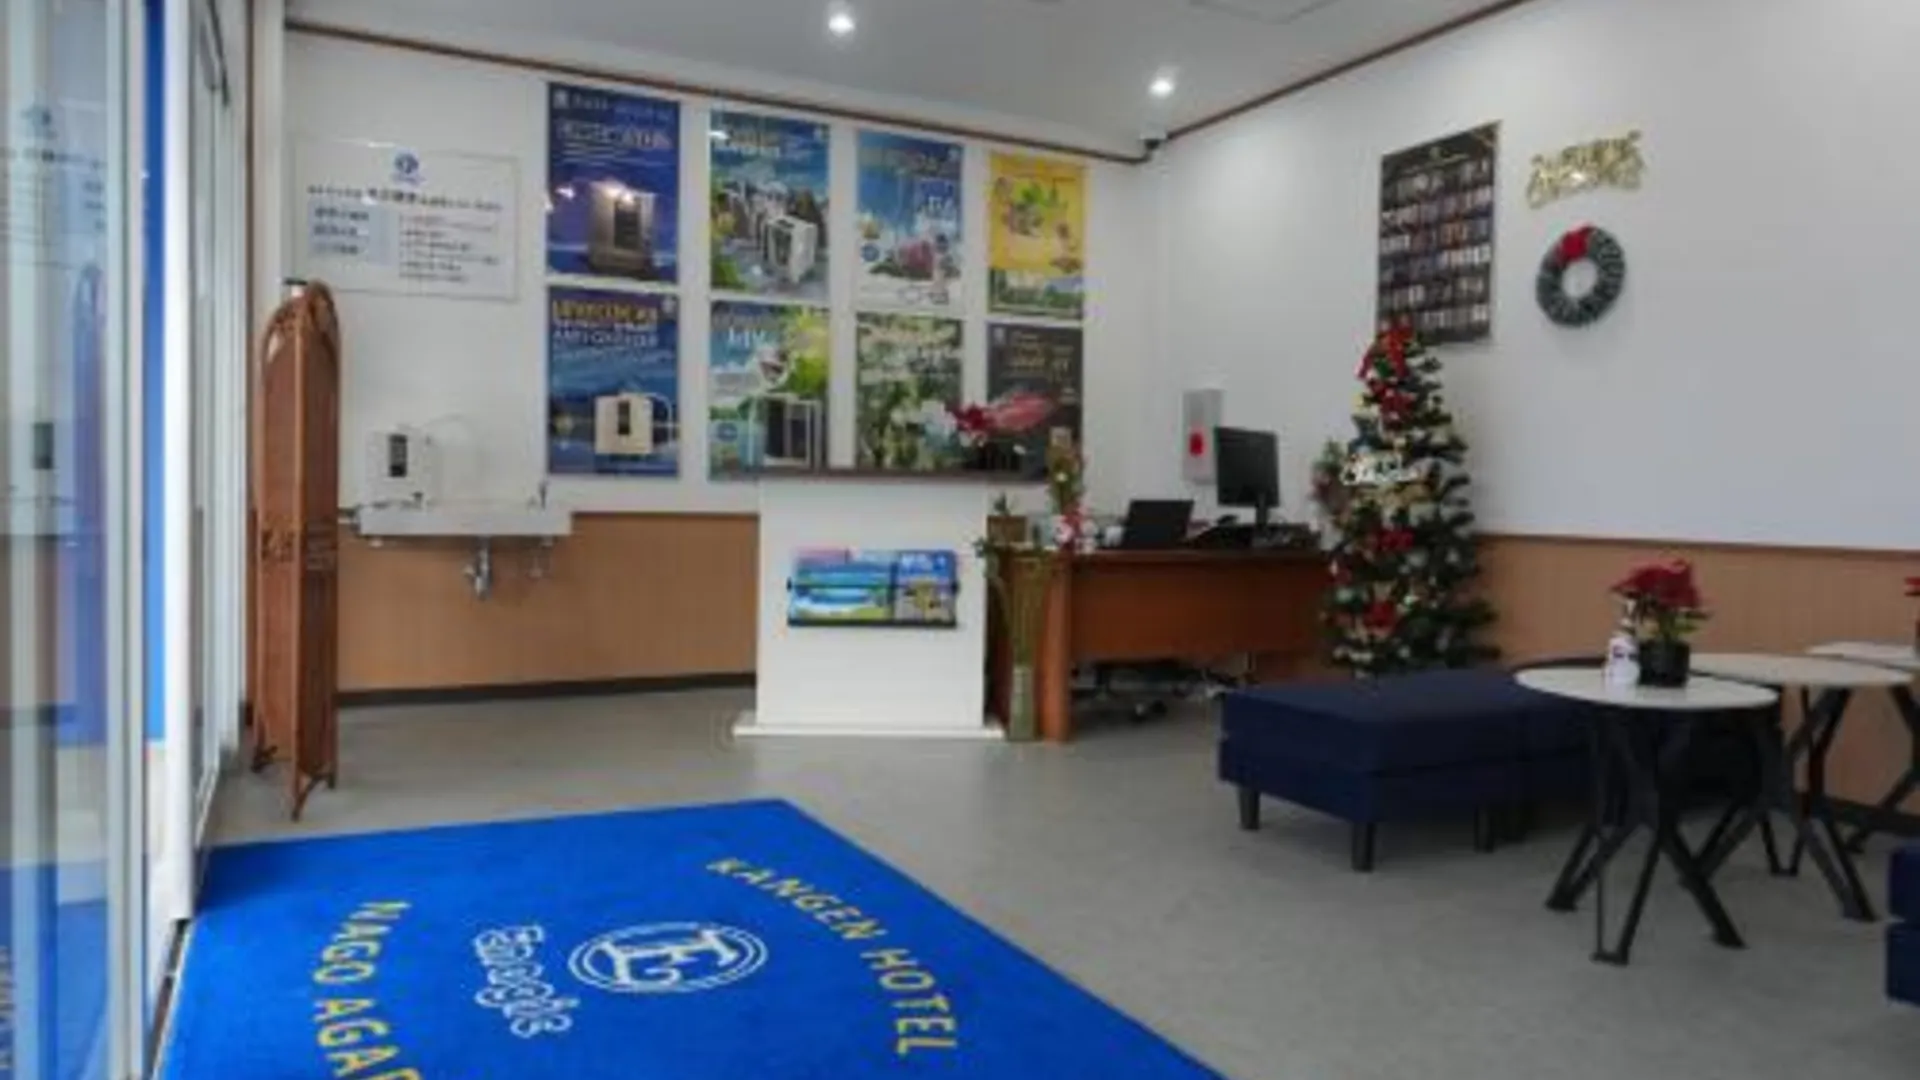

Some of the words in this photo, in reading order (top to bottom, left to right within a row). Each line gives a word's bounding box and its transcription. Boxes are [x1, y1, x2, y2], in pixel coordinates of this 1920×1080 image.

[313, 900, 412, 984] NAGO
[706, 858, 888, 939] KANGEN
[860, 948, 957, 1055] HOTEL
